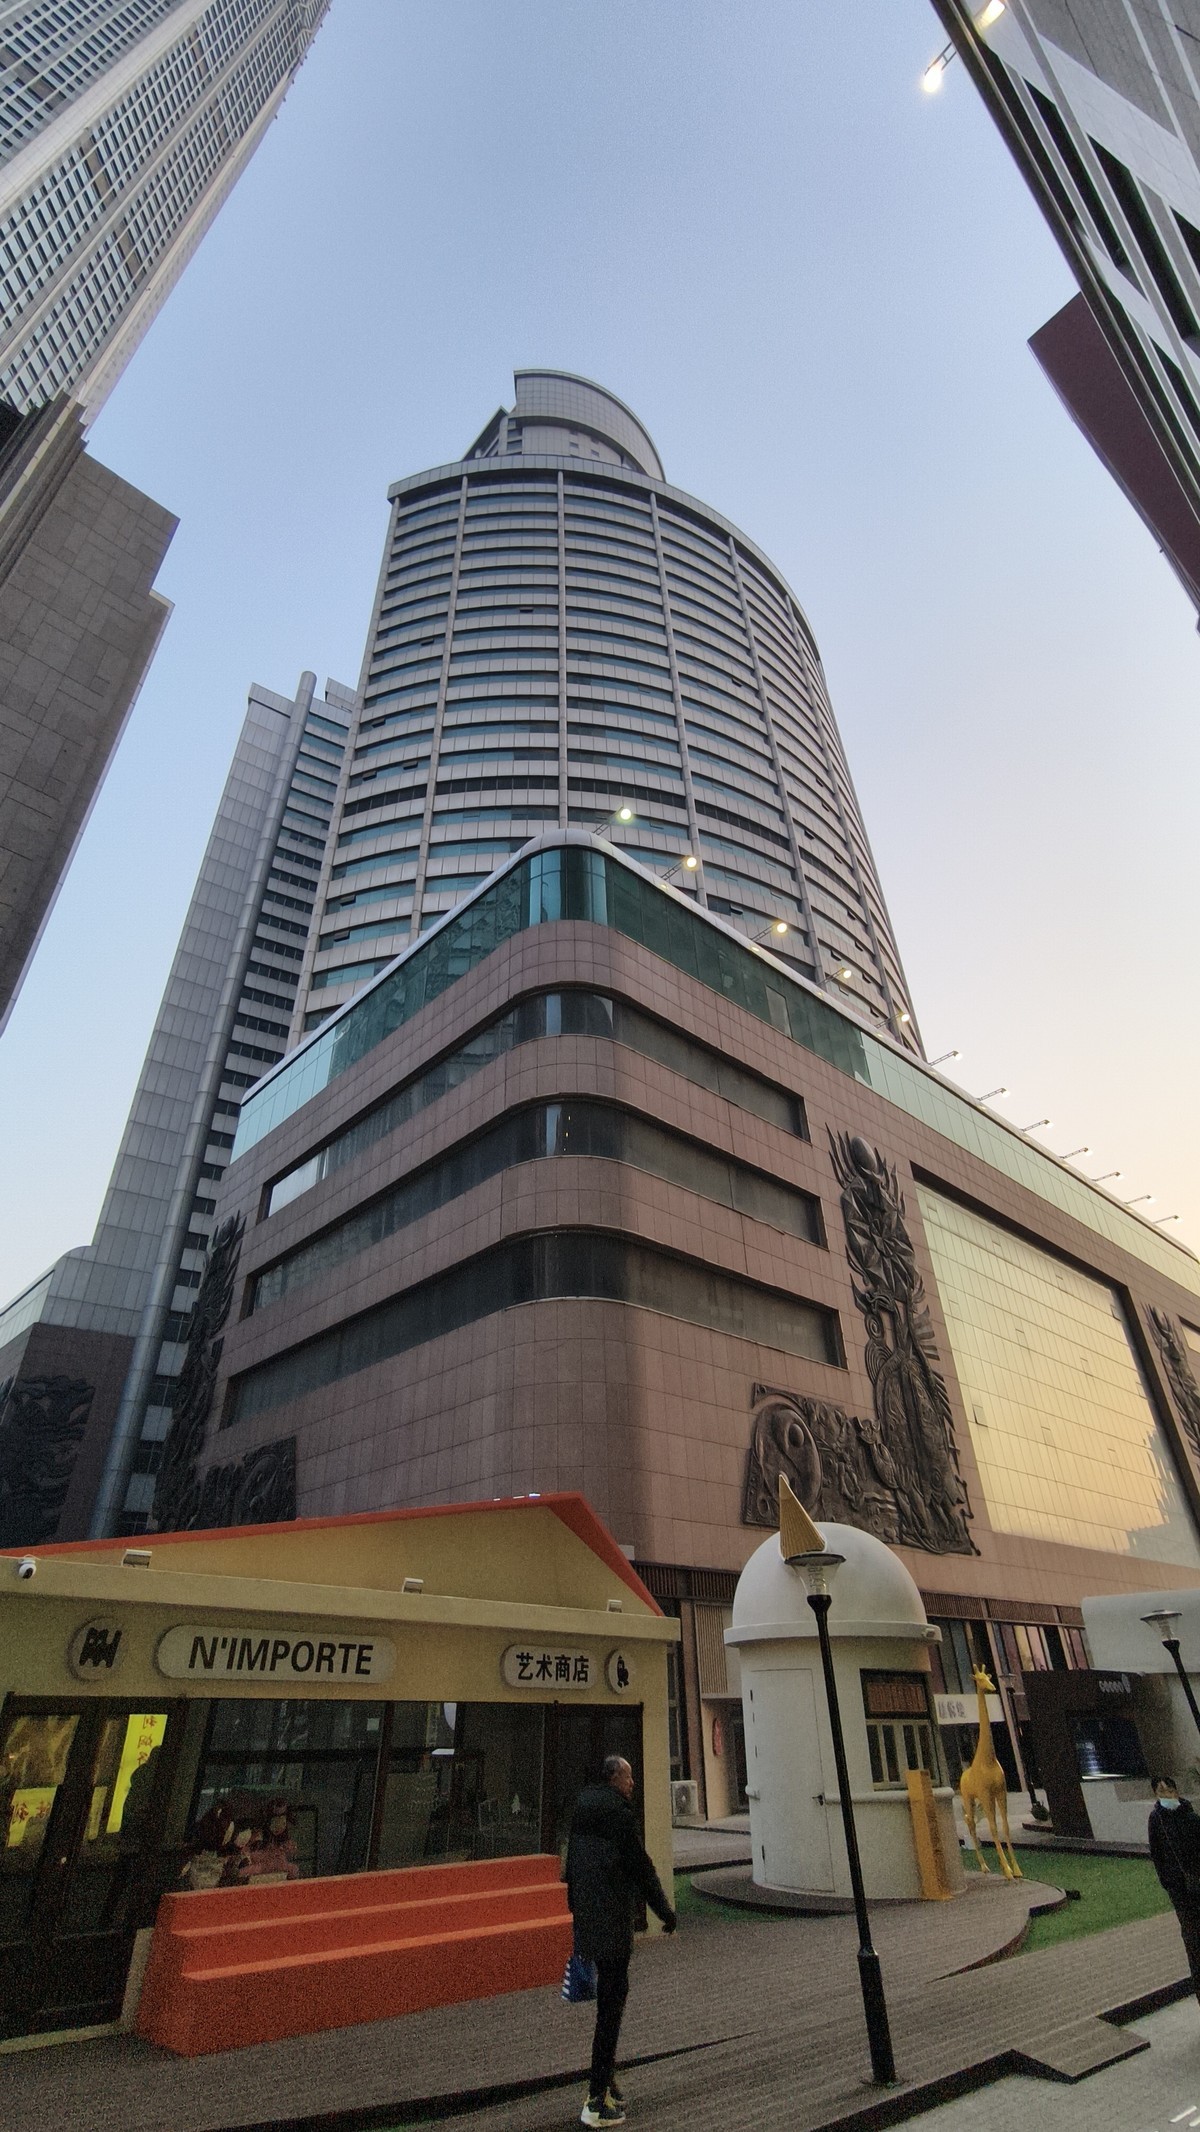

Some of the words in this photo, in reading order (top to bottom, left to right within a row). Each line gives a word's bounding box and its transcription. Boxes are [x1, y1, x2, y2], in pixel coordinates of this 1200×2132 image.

[188, 1636, 374, 1675] N'IMPORTE
[516, 1652, 589, 1682] 艺术商店
